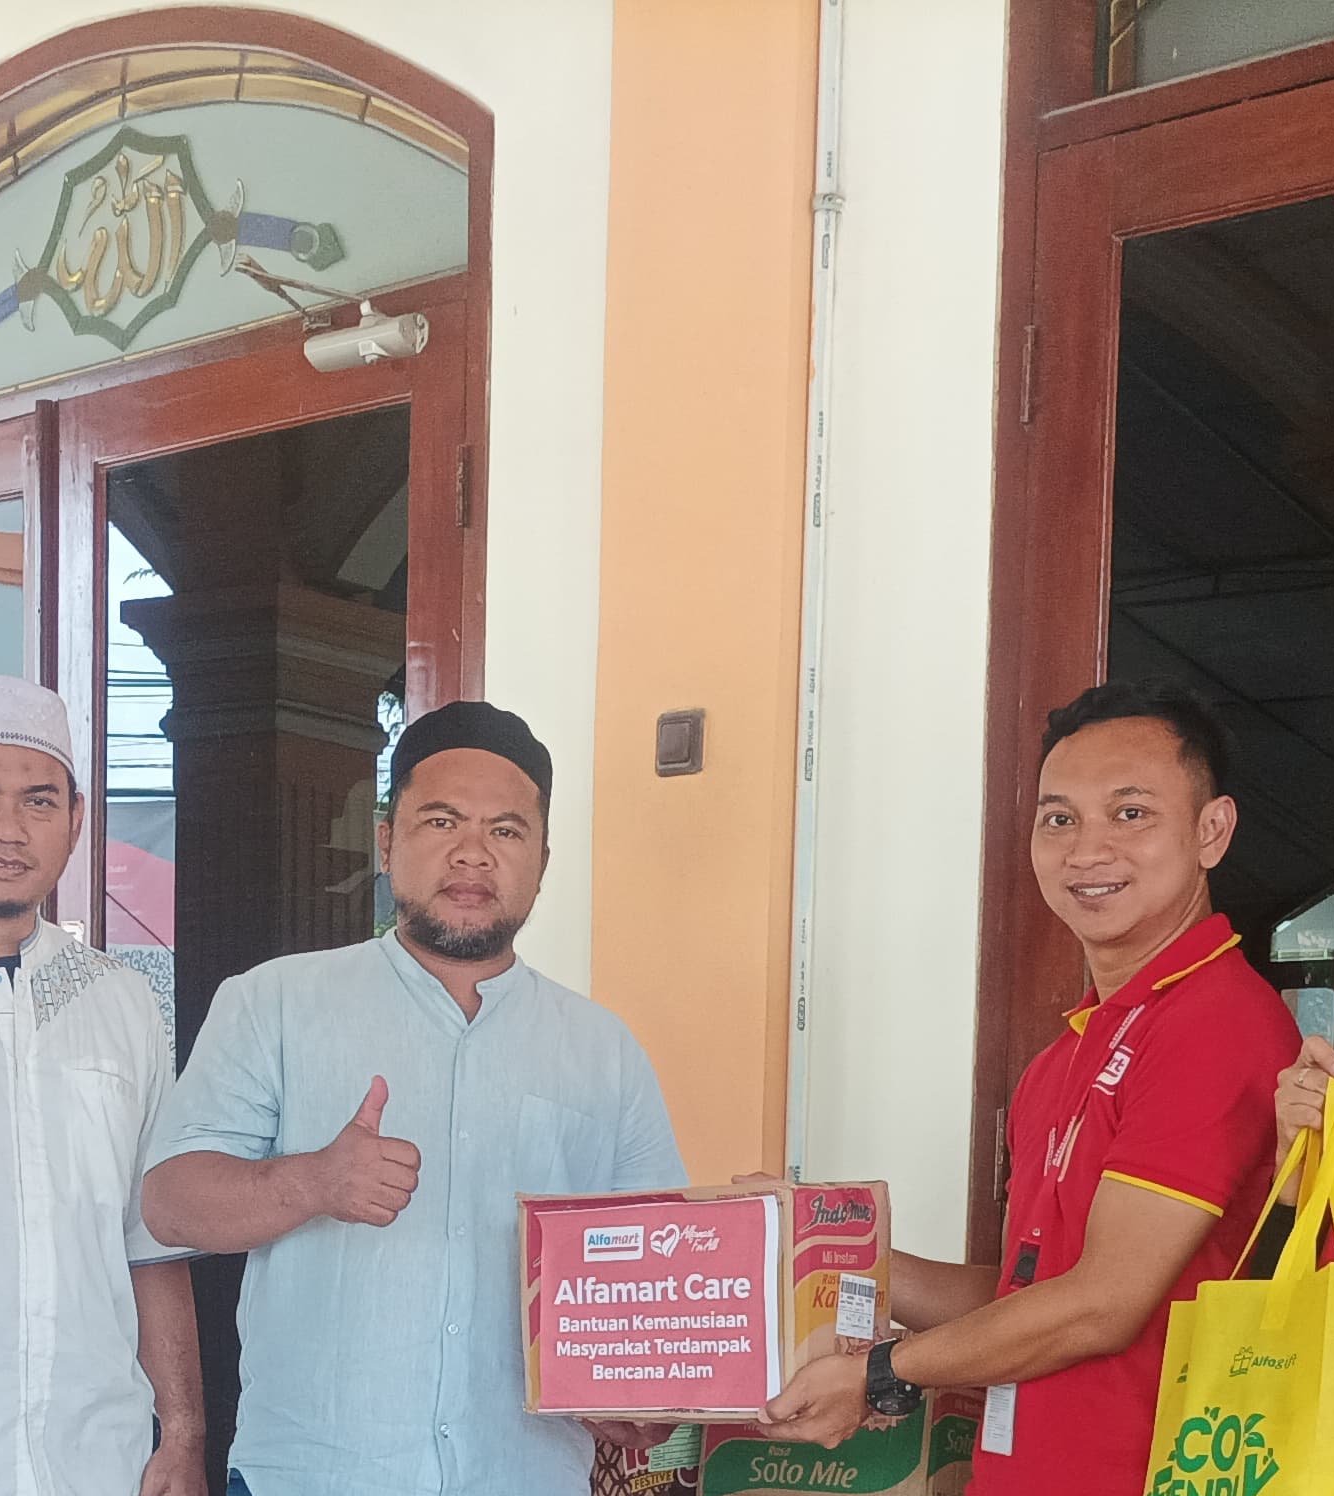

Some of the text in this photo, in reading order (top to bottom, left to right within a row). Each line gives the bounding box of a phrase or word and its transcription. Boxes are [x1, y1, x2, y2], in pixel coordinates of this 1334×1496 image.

[587, 1233, 639, 1246] Alfamart
[554, 1273, 751, 1305] Alfamart Care
[559, 1311, 748, 1333] Bantuan Kemanusiaan
[556, 1336, 751, 1359] Masyarakat Terdampak
[592, 1362, 713, 1380] Bencana Alam
[1175, 1414, 1242, 1473] CO
[634, 1472, 672, 1490] FESTIVE
[748, 1457, 858, 1488] Soto Mie
